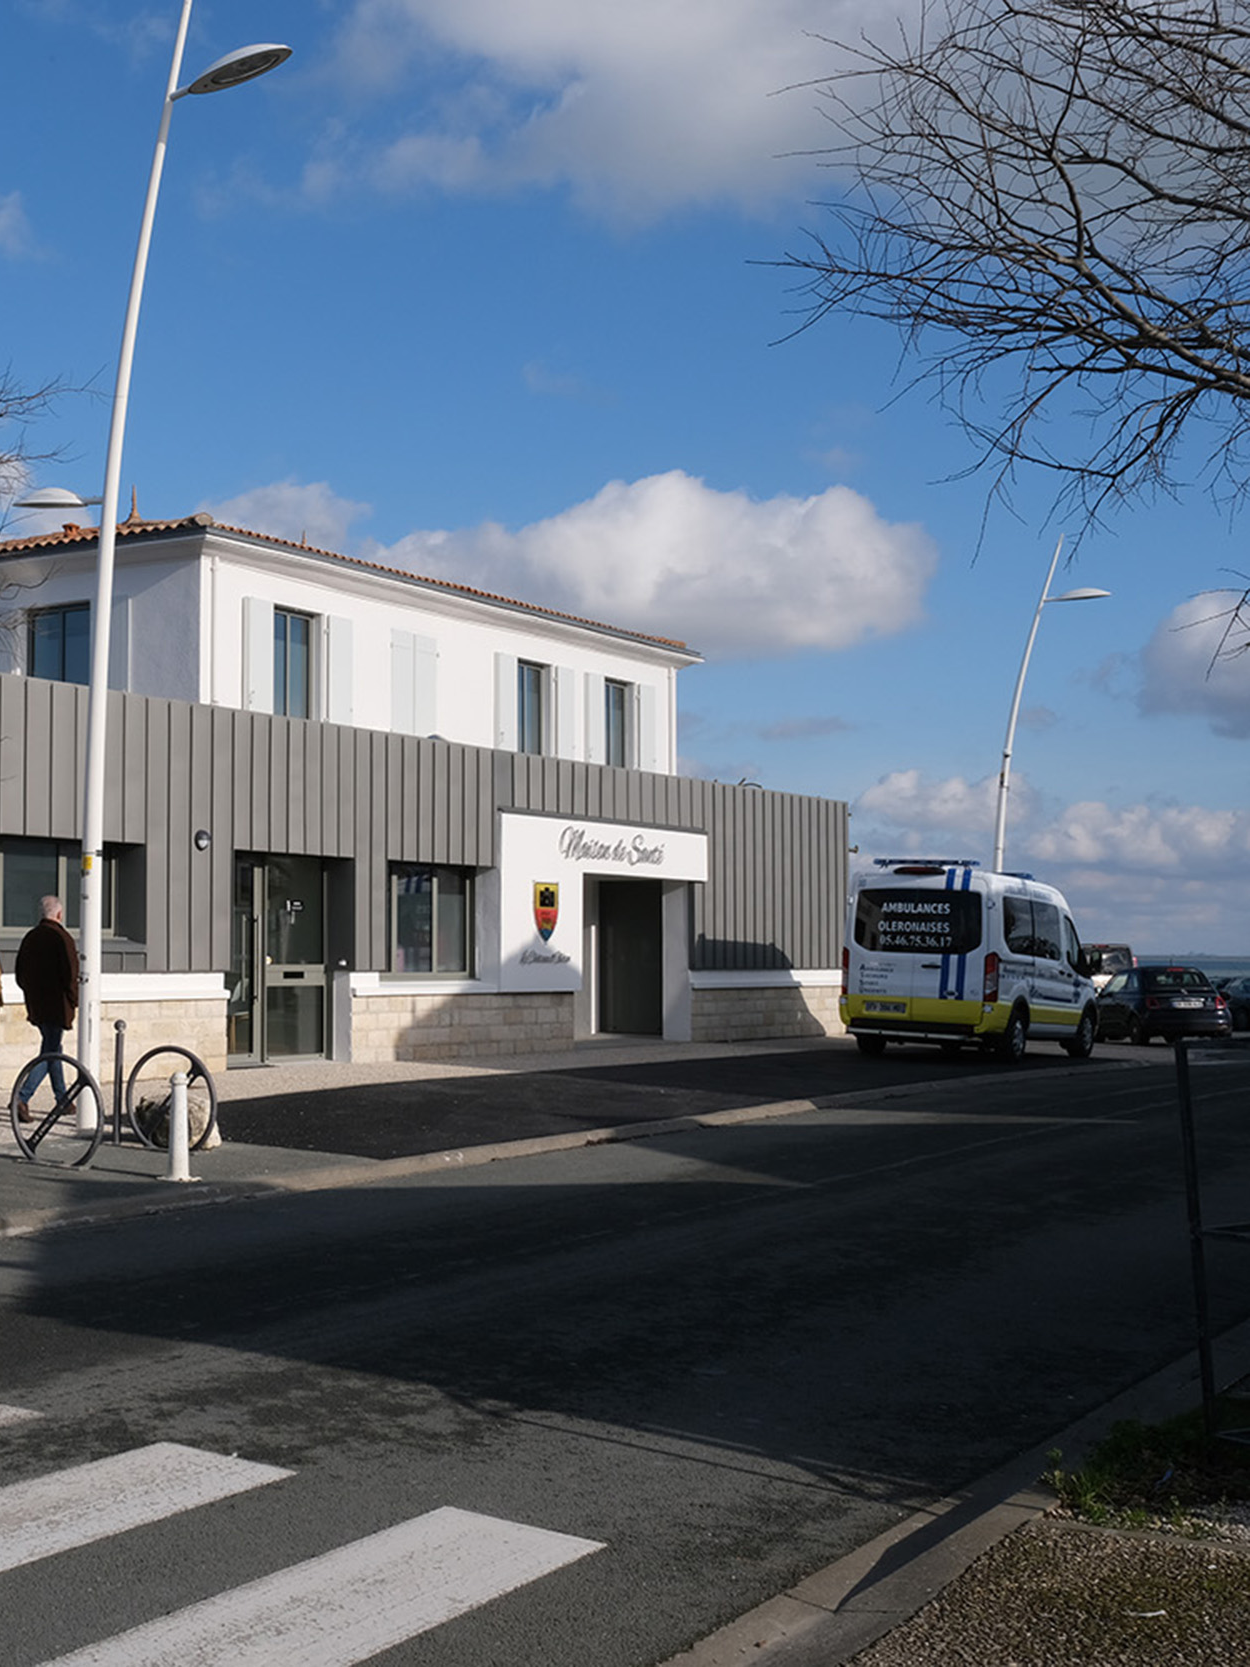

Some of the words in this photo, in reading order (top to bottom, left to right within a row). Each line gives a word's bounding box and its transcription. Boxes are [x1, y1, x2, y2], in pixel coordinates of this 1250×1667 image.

[558, 825, 611, 861] Maison
[611, 838, 626, 862] de
[626, 834, 666, 866] Santé
[881, 902, 951, 915] AMBULANCES
[877, 920, 950, 933] OLERONAISES
[879, 934, 953, 948] 05.46.75.36.17
